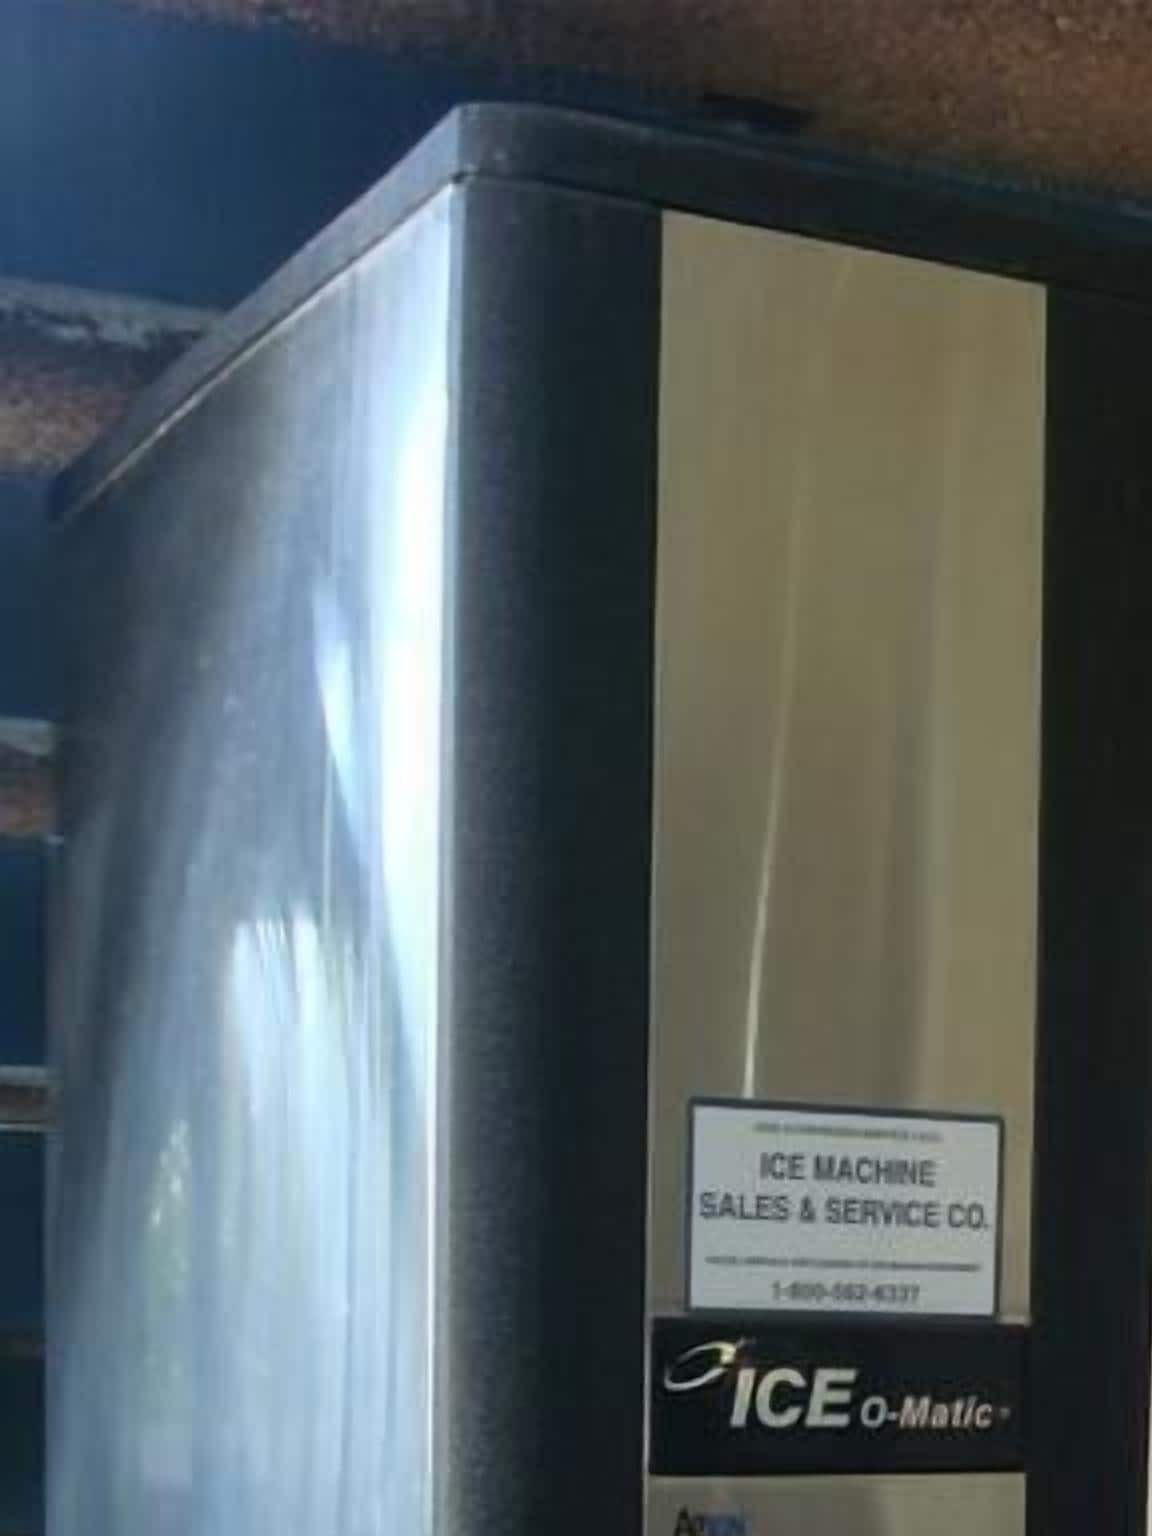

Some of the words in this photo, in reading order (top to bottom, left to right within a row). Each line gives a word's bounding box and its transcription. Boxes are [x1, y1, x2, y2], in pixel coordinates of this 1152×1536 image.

[760, 1152, 805, 1180] ICE
[813, 1155, 936, 1187] MACHINE
[699, 1192, 789, 1221] SALES
[800, 1197, 815, 1224] &
[825, 1198, 940, 1228] SERVICE
[948, 1203, 989, 1230] CO.
[729, 1367, 856, 1428] ICE
[860, 1395, 993, 1429] O-Matic
